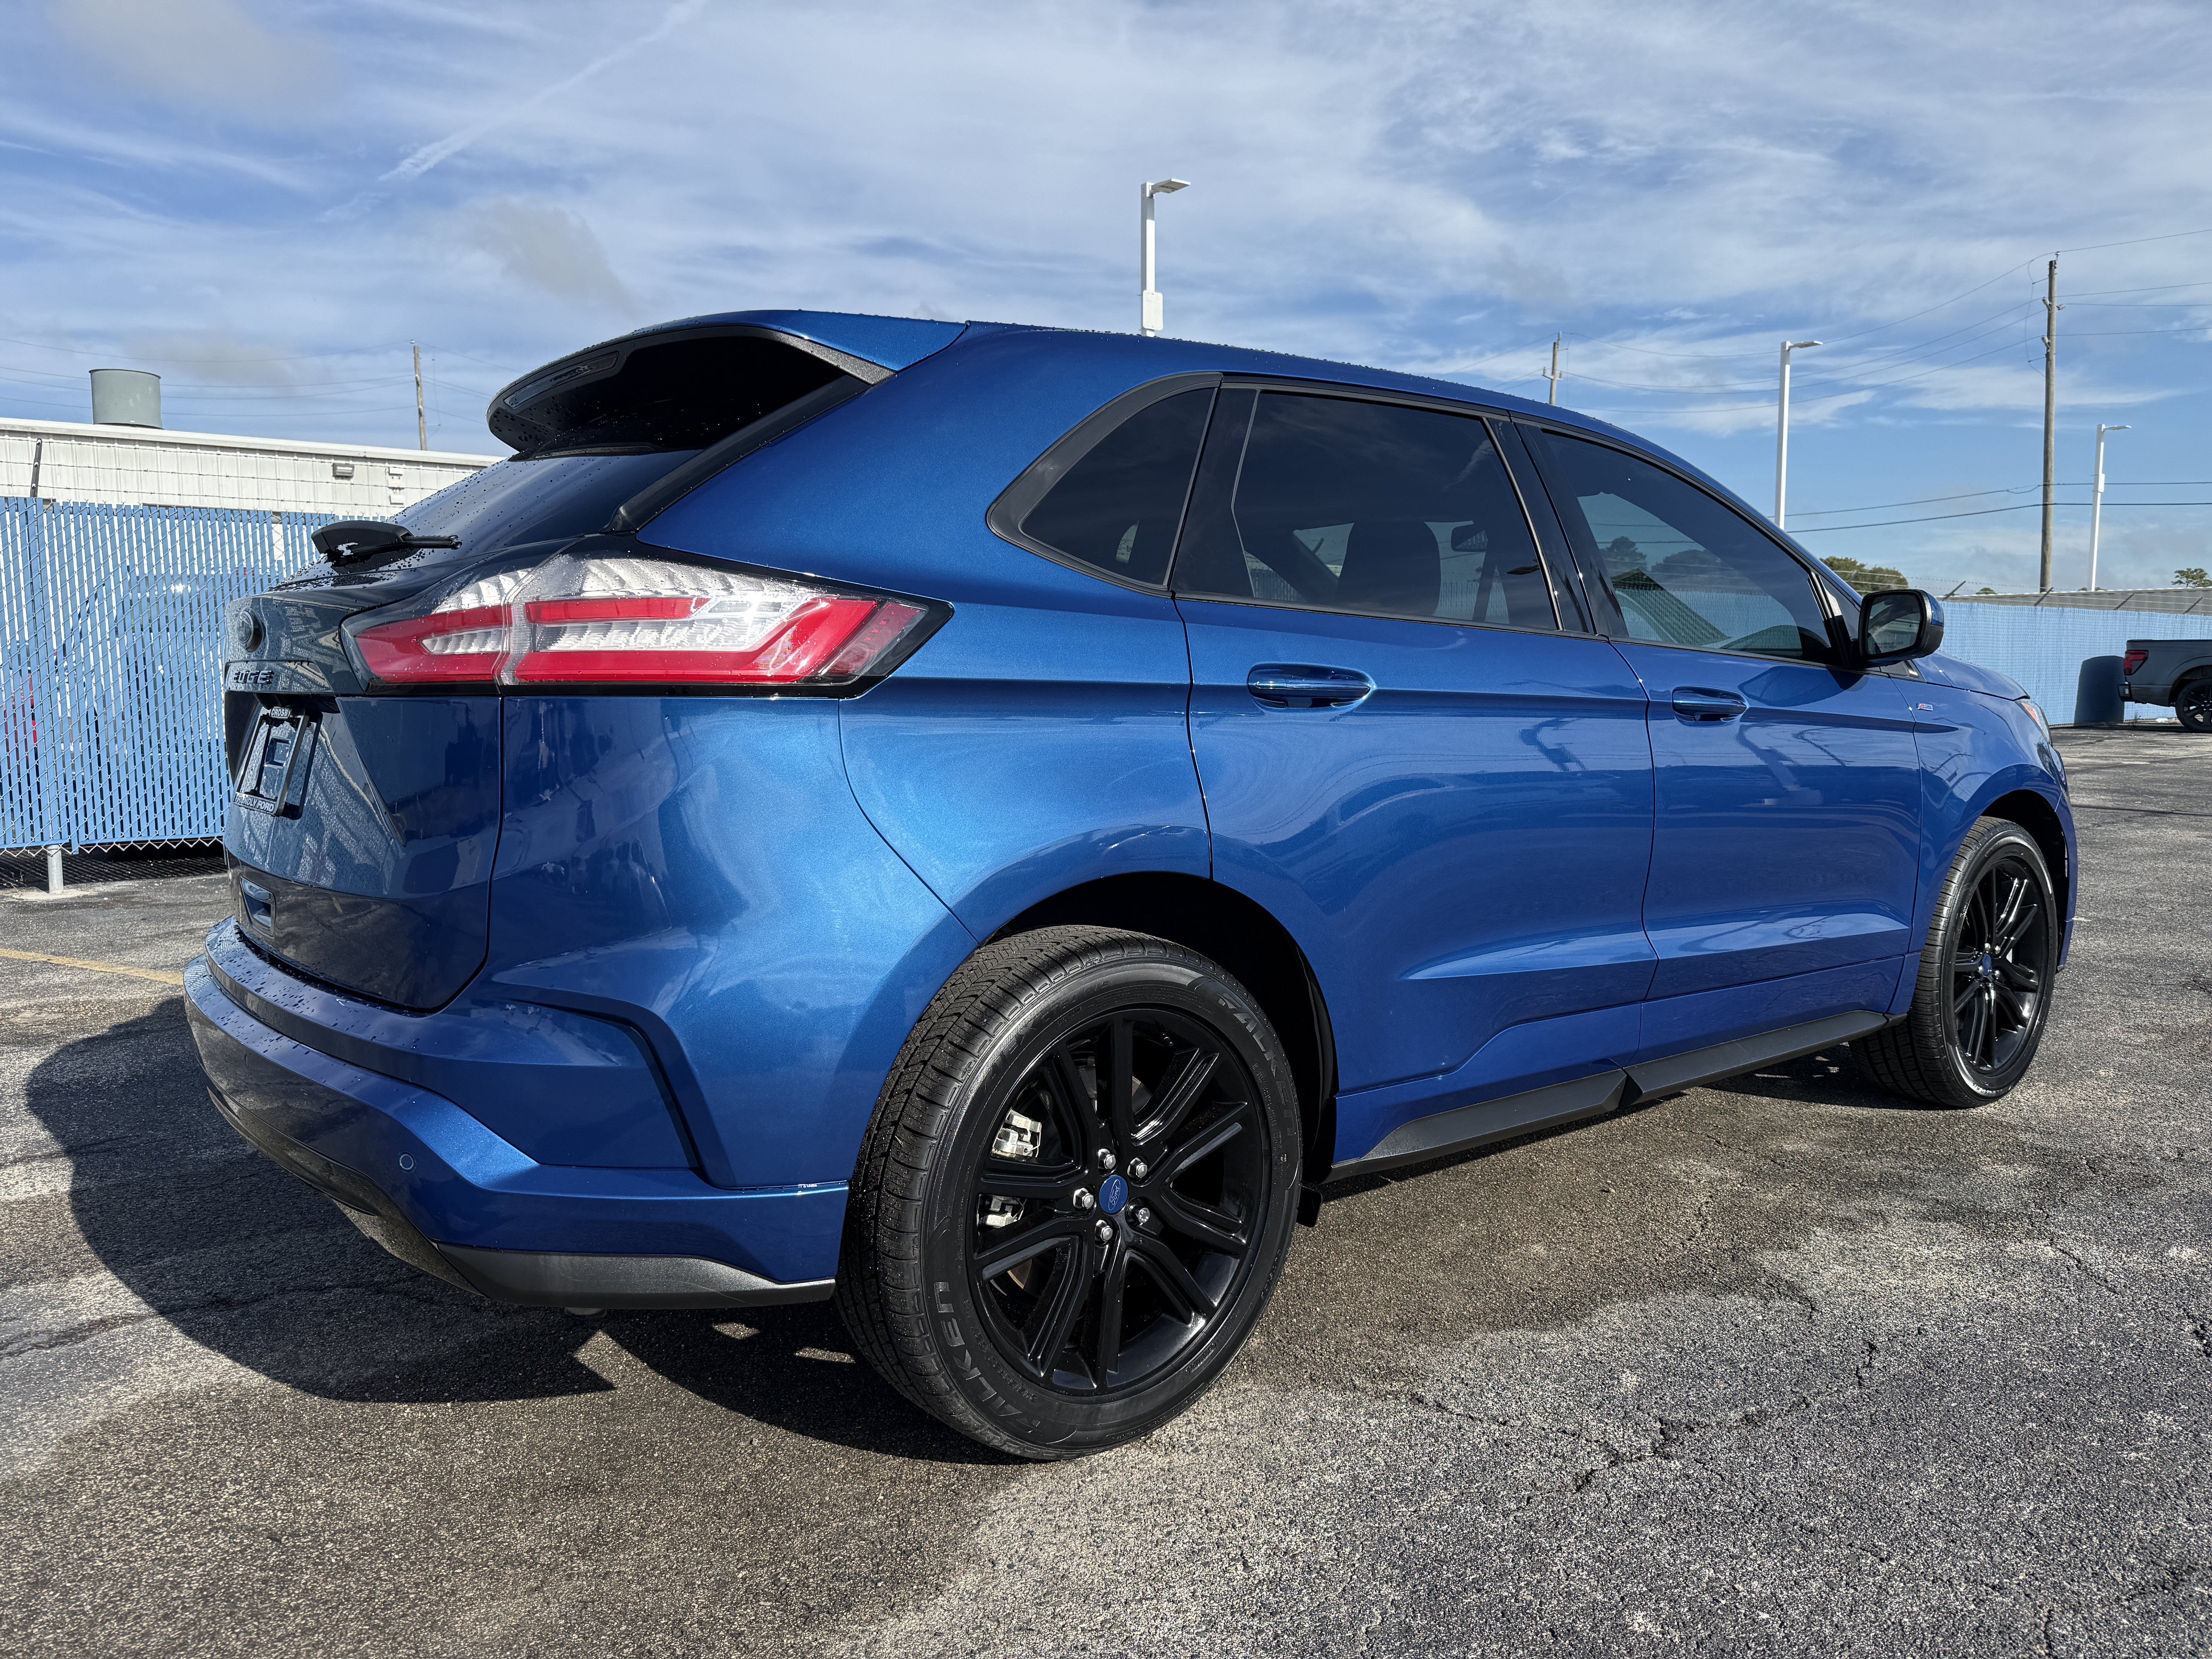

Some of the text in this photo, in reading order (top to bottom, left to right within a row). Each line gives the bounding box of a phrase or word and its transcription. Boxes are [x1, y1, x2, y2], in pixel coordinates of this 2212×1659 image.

[232, 670, 273, 684] EDGE
[271, 708, 292, 718] CROSBY
[256, 799, 275, 812] FORD
[1217, 992, 1296, 1136] FALKEN
[1110, 1185, 1119, 1206] Ford
[933, 1281, 1042, 1433] FALKEN
